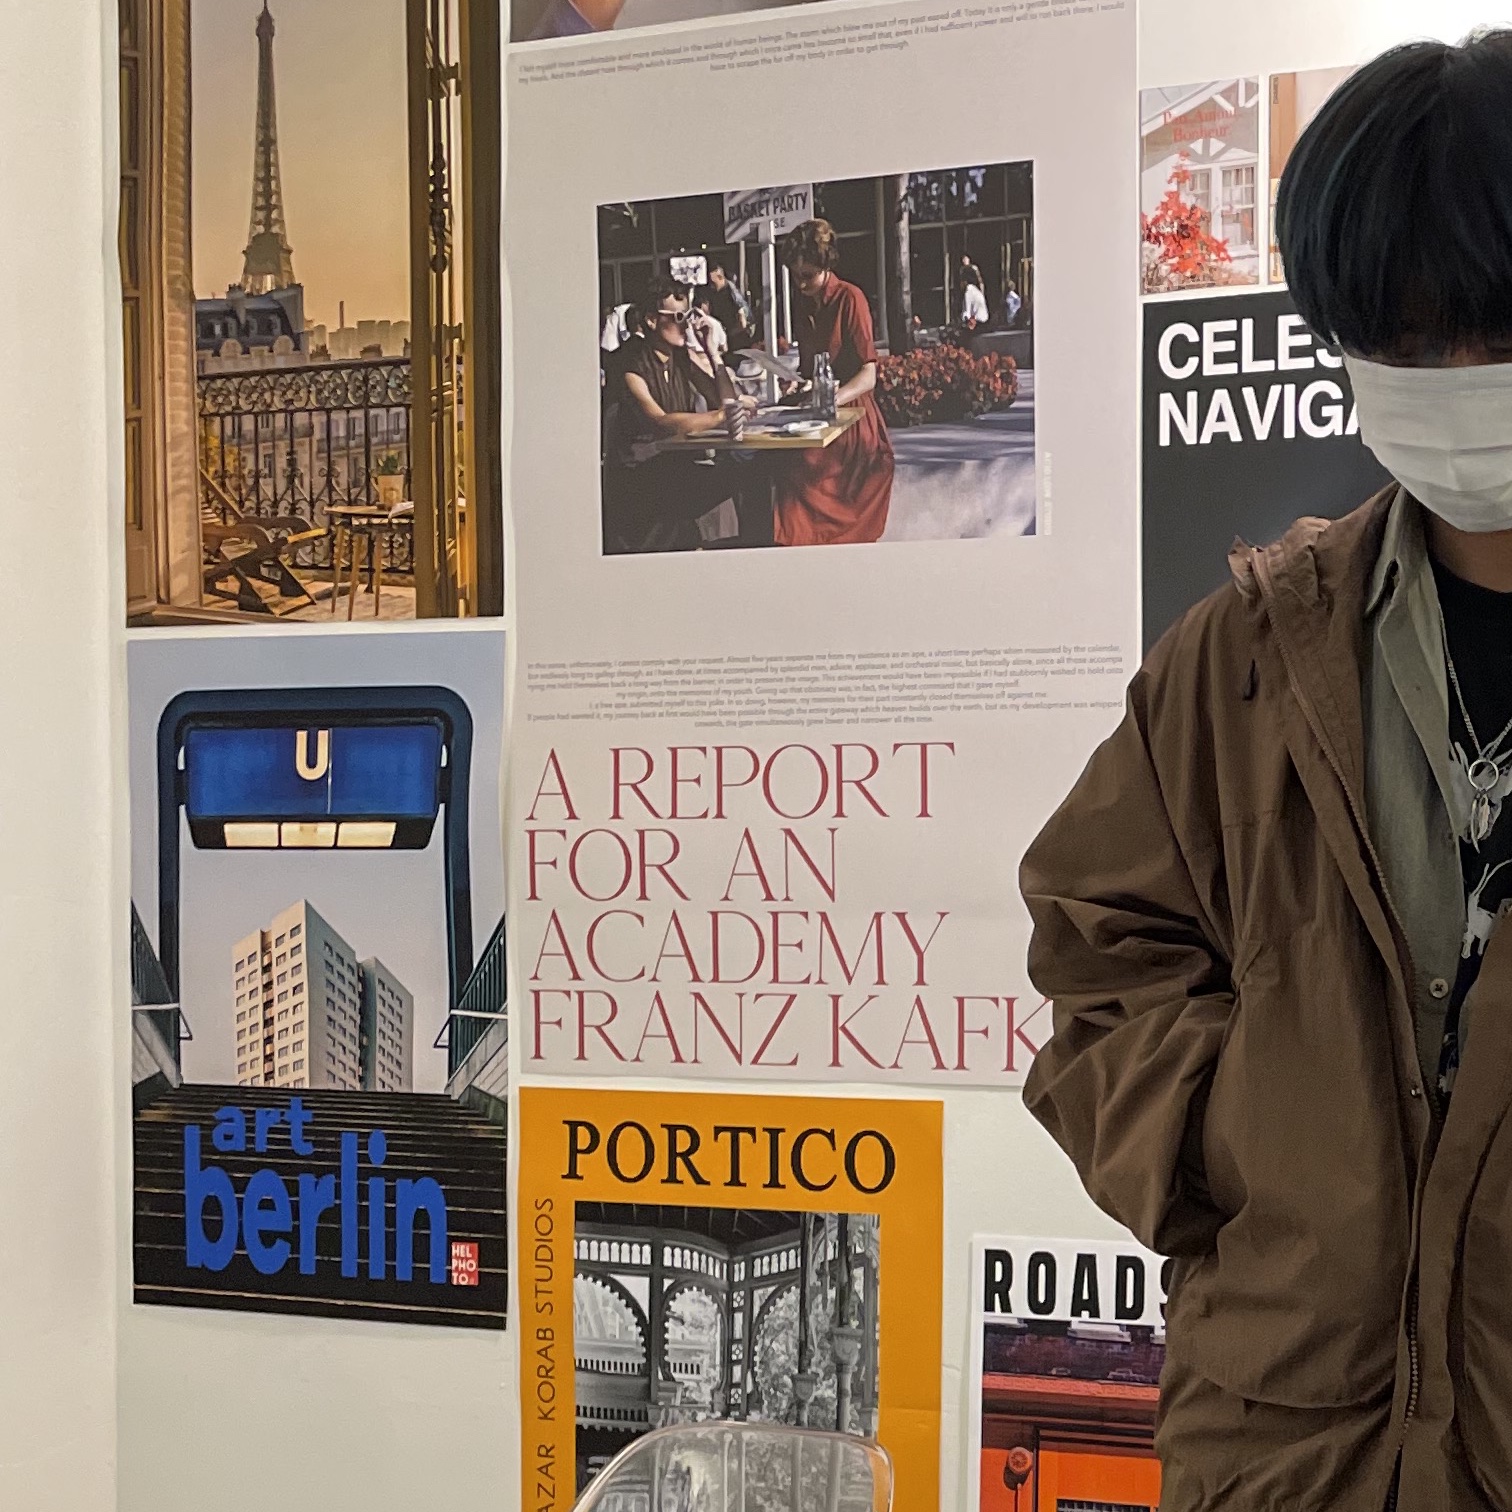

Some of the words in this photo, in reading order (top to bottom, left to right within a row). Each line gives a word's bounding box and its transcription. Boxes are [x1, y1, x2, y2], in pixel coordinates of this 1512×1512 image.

[773, 192, 808, 215] PARTY
[1158, 313, 1344, 380] CELE
[295, 730, 329, 782] U
[525, 747, 580, 821] A
[609, 742, 956, 821] REPORT
[524, 828, 692, 902] FOR
[719, 827, 839, 902] AN
[529, 909, 950, 987] ACADEMY
[529, 989, 800, 1068] FRANZ
[827, 994, 1053, 1073] KAFK
[212, 1097, 314, 1156] art
[561, 1120, 897, 1195] PORTICO
[184, 1124, 448, 1285] berlin
[452, 1244, 473, 1258] HEL
[452, 1258, 477, 1272] PHO
[534, 1198, 554, 1316] STUDIOS
[536, 1327, 555, 1422] KORAB
